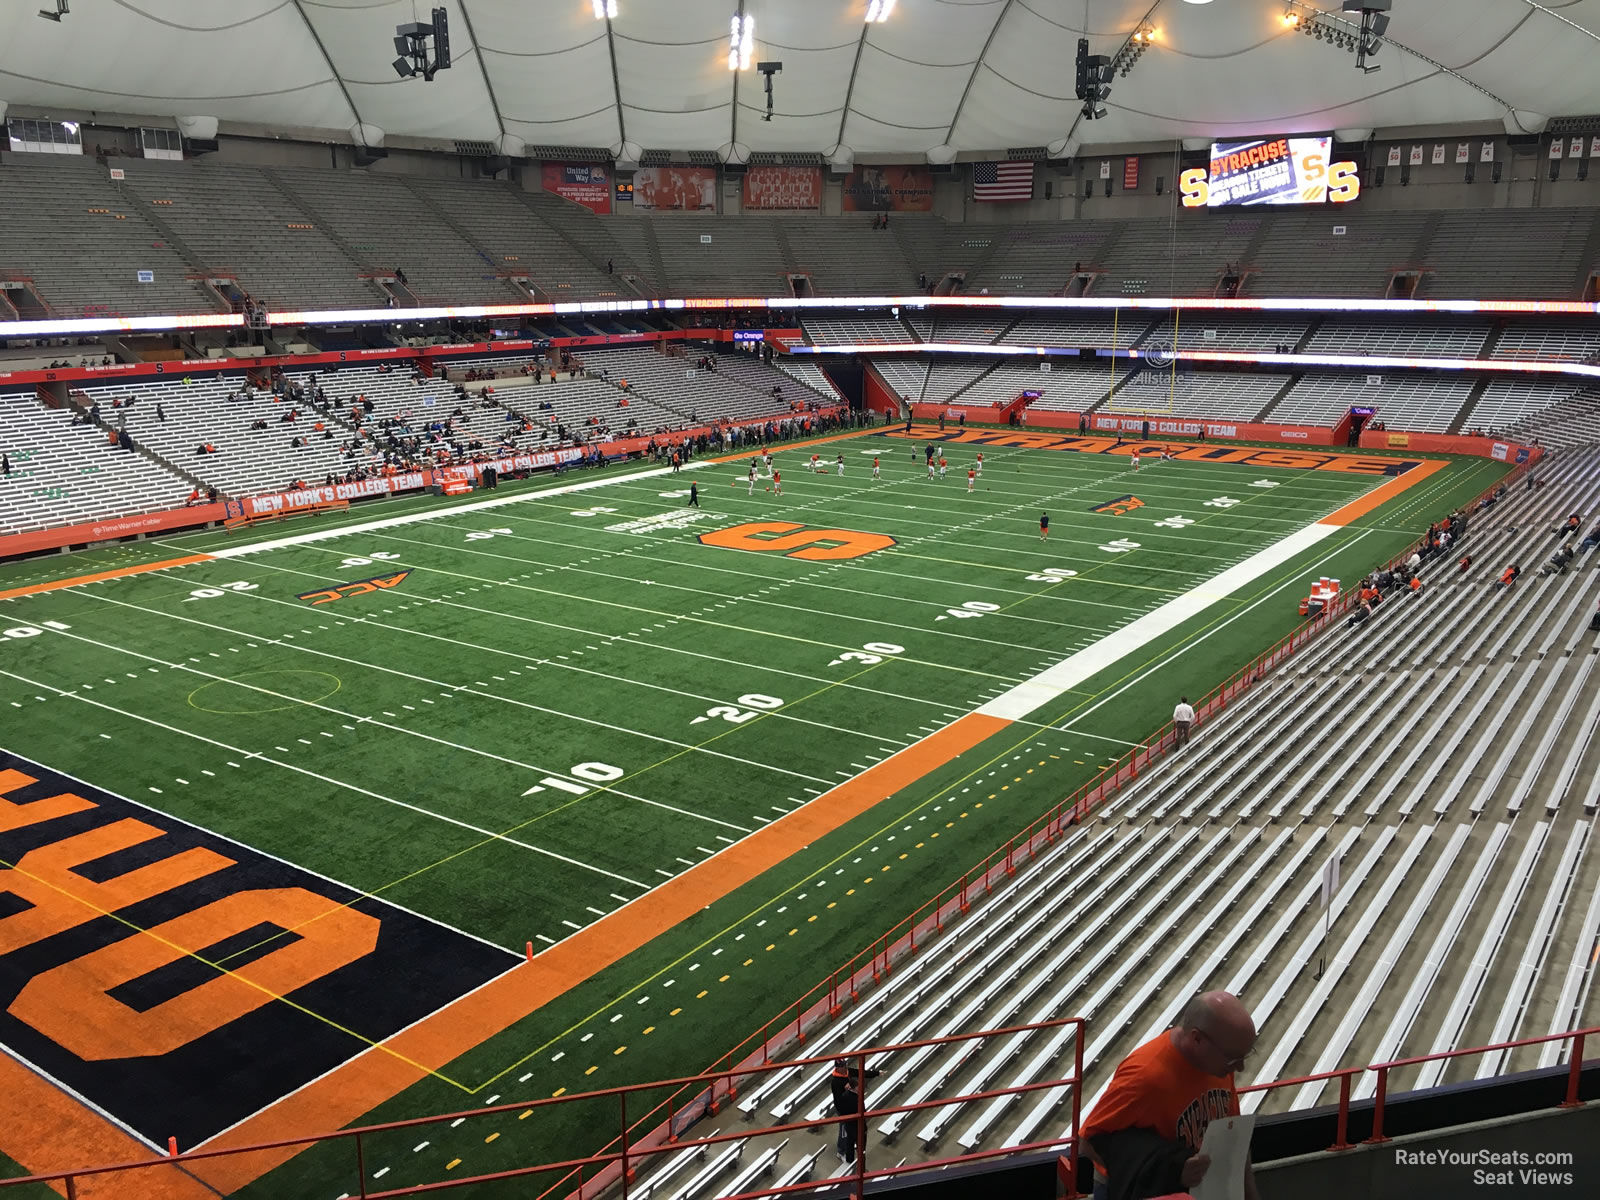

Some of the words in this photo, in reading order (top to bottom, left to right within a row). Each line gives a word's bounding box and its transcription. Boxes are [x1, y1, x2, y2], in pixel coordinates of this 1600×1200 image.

[1210, 139, 1289, 176] SYRACUSE
[1302, 154, 1325, 181] S
[566, 167, 589, 175] United
[575, 174, 589, 183] Way
[1249, 161, 1289, 182] TICKETS
[1179, 168, 1209, 207] S
[1232, 179, 1259, 200] SALE
[1327, 161, 1360, 202] S
[685, 299, 727, 308] SYRACUSE
[728, 298, 768, 308] FOOTBALL
[734, 332, 743, 340] Go
[744, 332, 764, 341] Orange
[156, 363, 164, 374] S
[1136, 372, 1184, 384] Allstate
[1096, 418, 1118, 429] NEW
[1120, 419, 1156, 430] YORS
[1208, 424, 1236, 436] TEAM
[879, 423, 1392, 475] SYRACUSE
[514, 452, 556, 472] COLLEGE
[556, 448, 582, 463] TEAM
[228, 500, 242, 518] S
[252, 496, 282, 514] NEW
[287, 486, 334, 508] YORK'S
[336, 478, 390, 500] COLLEGE
[391, 473, 424, 490] TEAM
[102, 522, 119, 532] Time
[118, 520, 142, 531] Warner
[142, 518, 161, 527] Cable
[698, 522, 898, 560] S
[342, 552, 400, 566] 30
[1026, 568, 1078, 583] 50
[190, 580, 259, 599] 20
[946, 600, 1001, 620] 40
[2, 620, 72, 638] 10
[840, 642, 906, 664] 30
[706, 694, 784, 724] 20
[539, 762, 624, 796] 10
